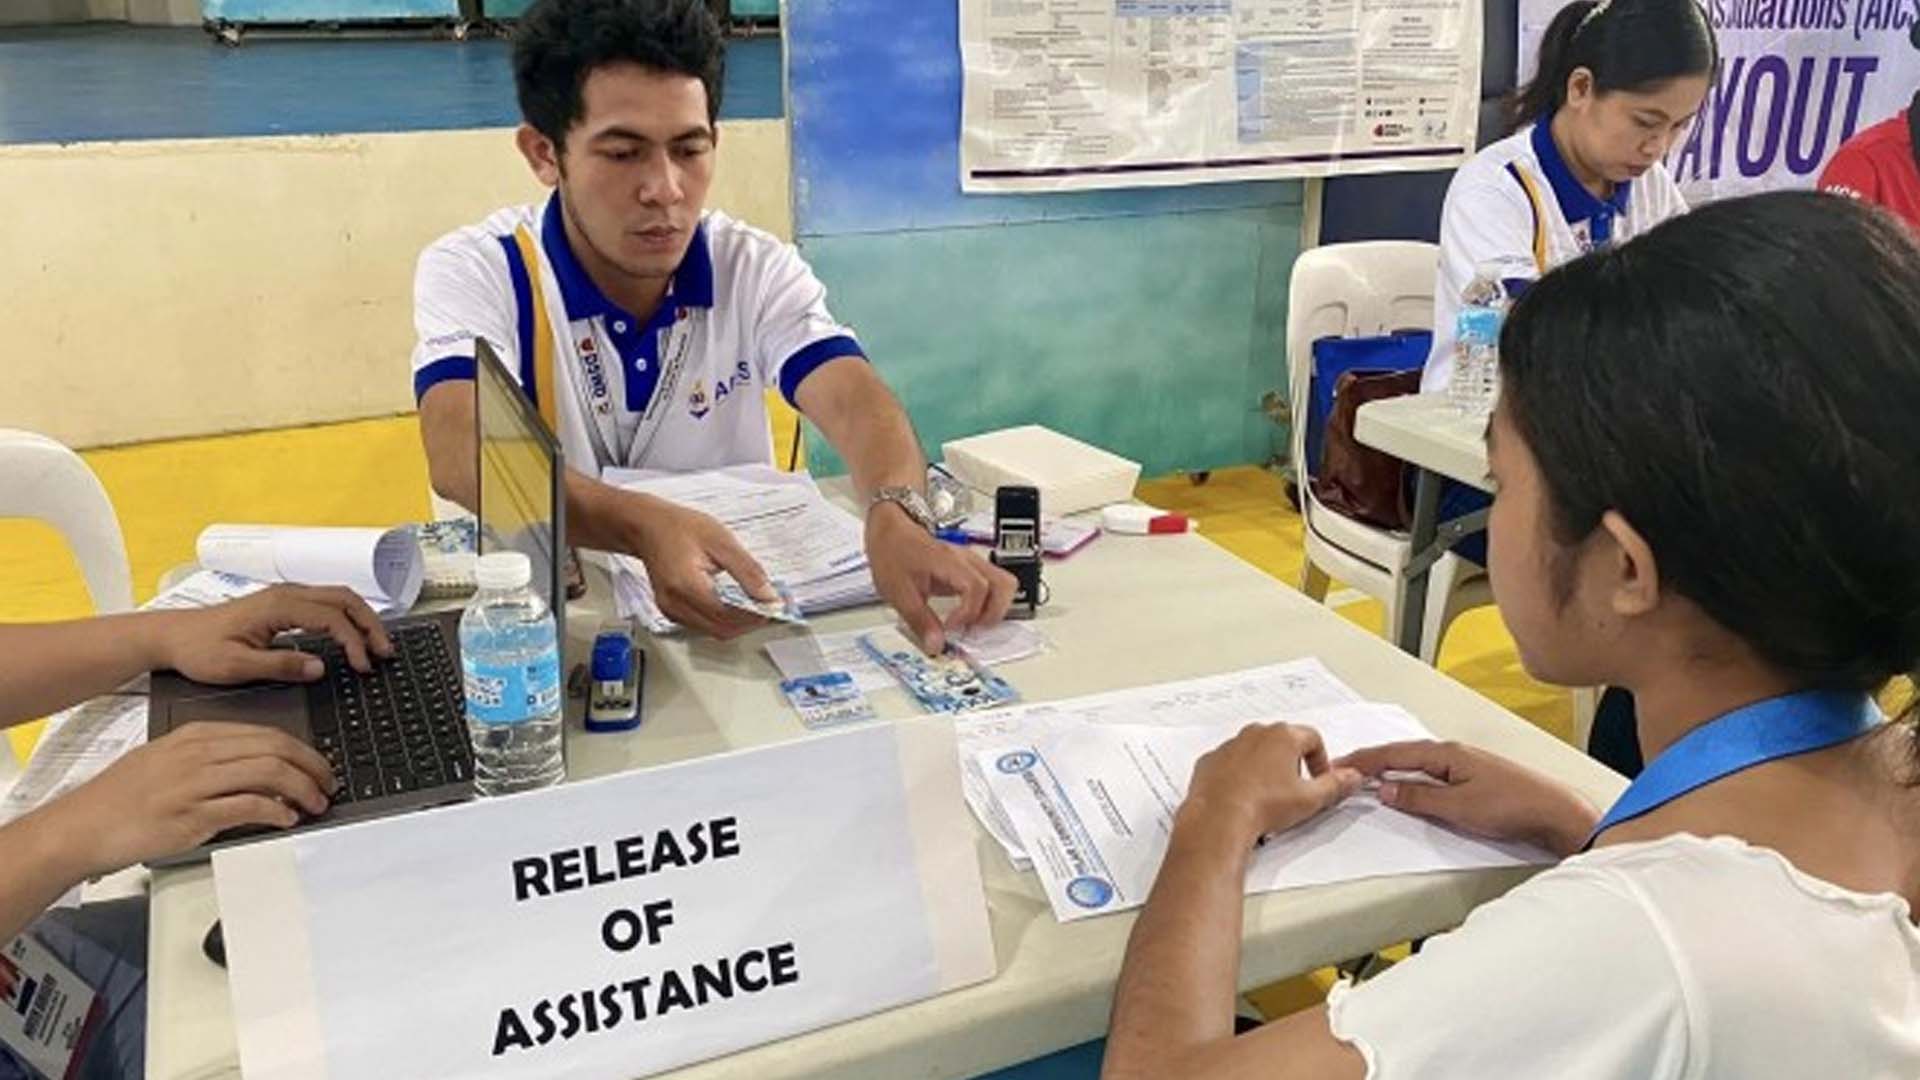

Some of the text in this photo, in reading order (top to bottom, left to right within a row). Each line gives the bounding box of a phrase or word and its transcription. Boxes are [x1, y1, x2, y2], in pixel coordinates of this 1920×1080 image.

[1667, 55, 1879, 183] AYOUT
[714, 361, 751, 401] AIS
[513, 817, 740, 901] RELEASE
[602, 900, 674, 952] OF
[492, 943, 799, 1056] ASSISTANCE
